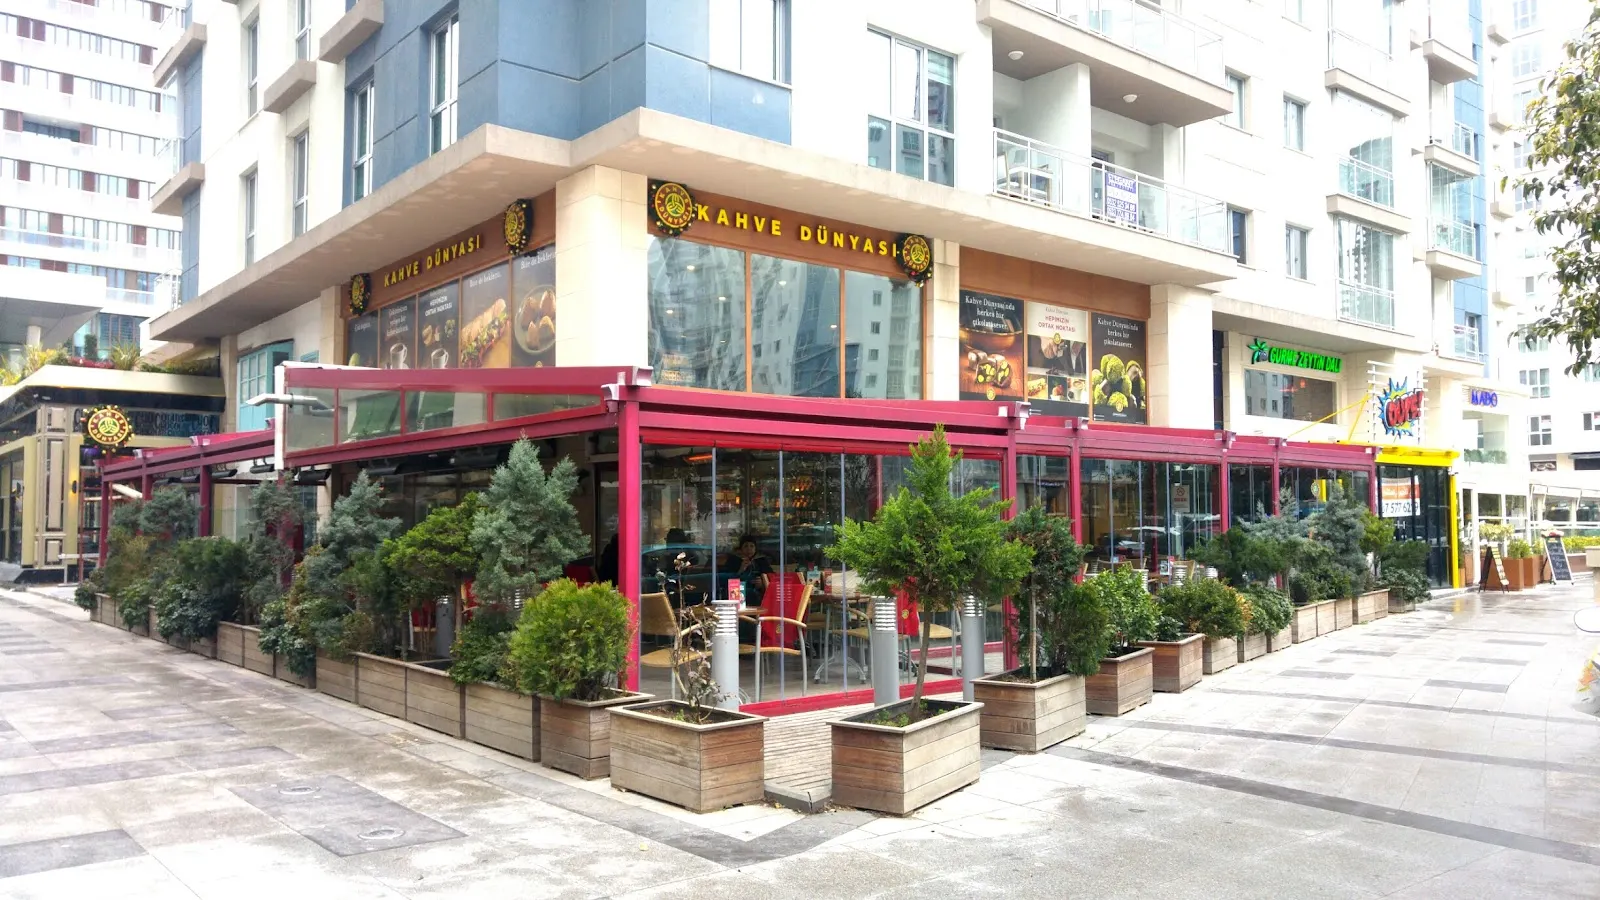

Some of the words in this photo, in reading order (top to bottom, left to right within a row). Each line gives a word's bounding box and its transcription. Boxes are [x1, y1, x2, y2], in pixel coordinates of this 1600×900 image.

[697, 204, 782, 236] KAHVE
[800, 225, 898, 258] DÜNYASI
[384, 261, 419, 287] KAHVE
[426, 235, 480, 270] DÜNYASI
[965, 296, 982, 306] Kahve
[976, 308, 995, 318] herkes
[995, 310, 1005, 319] bir
[1097, 317, 1112, 326] Kahve
[1038, 322, 1054, 330] ORTAK
[1055, 324, 1076, 333] NOKTASI
[1107, 328, 1122, 338] herkes
[1269, 347, 1298, 366] GURME
[1471, 389, 1498, 408] MADO
